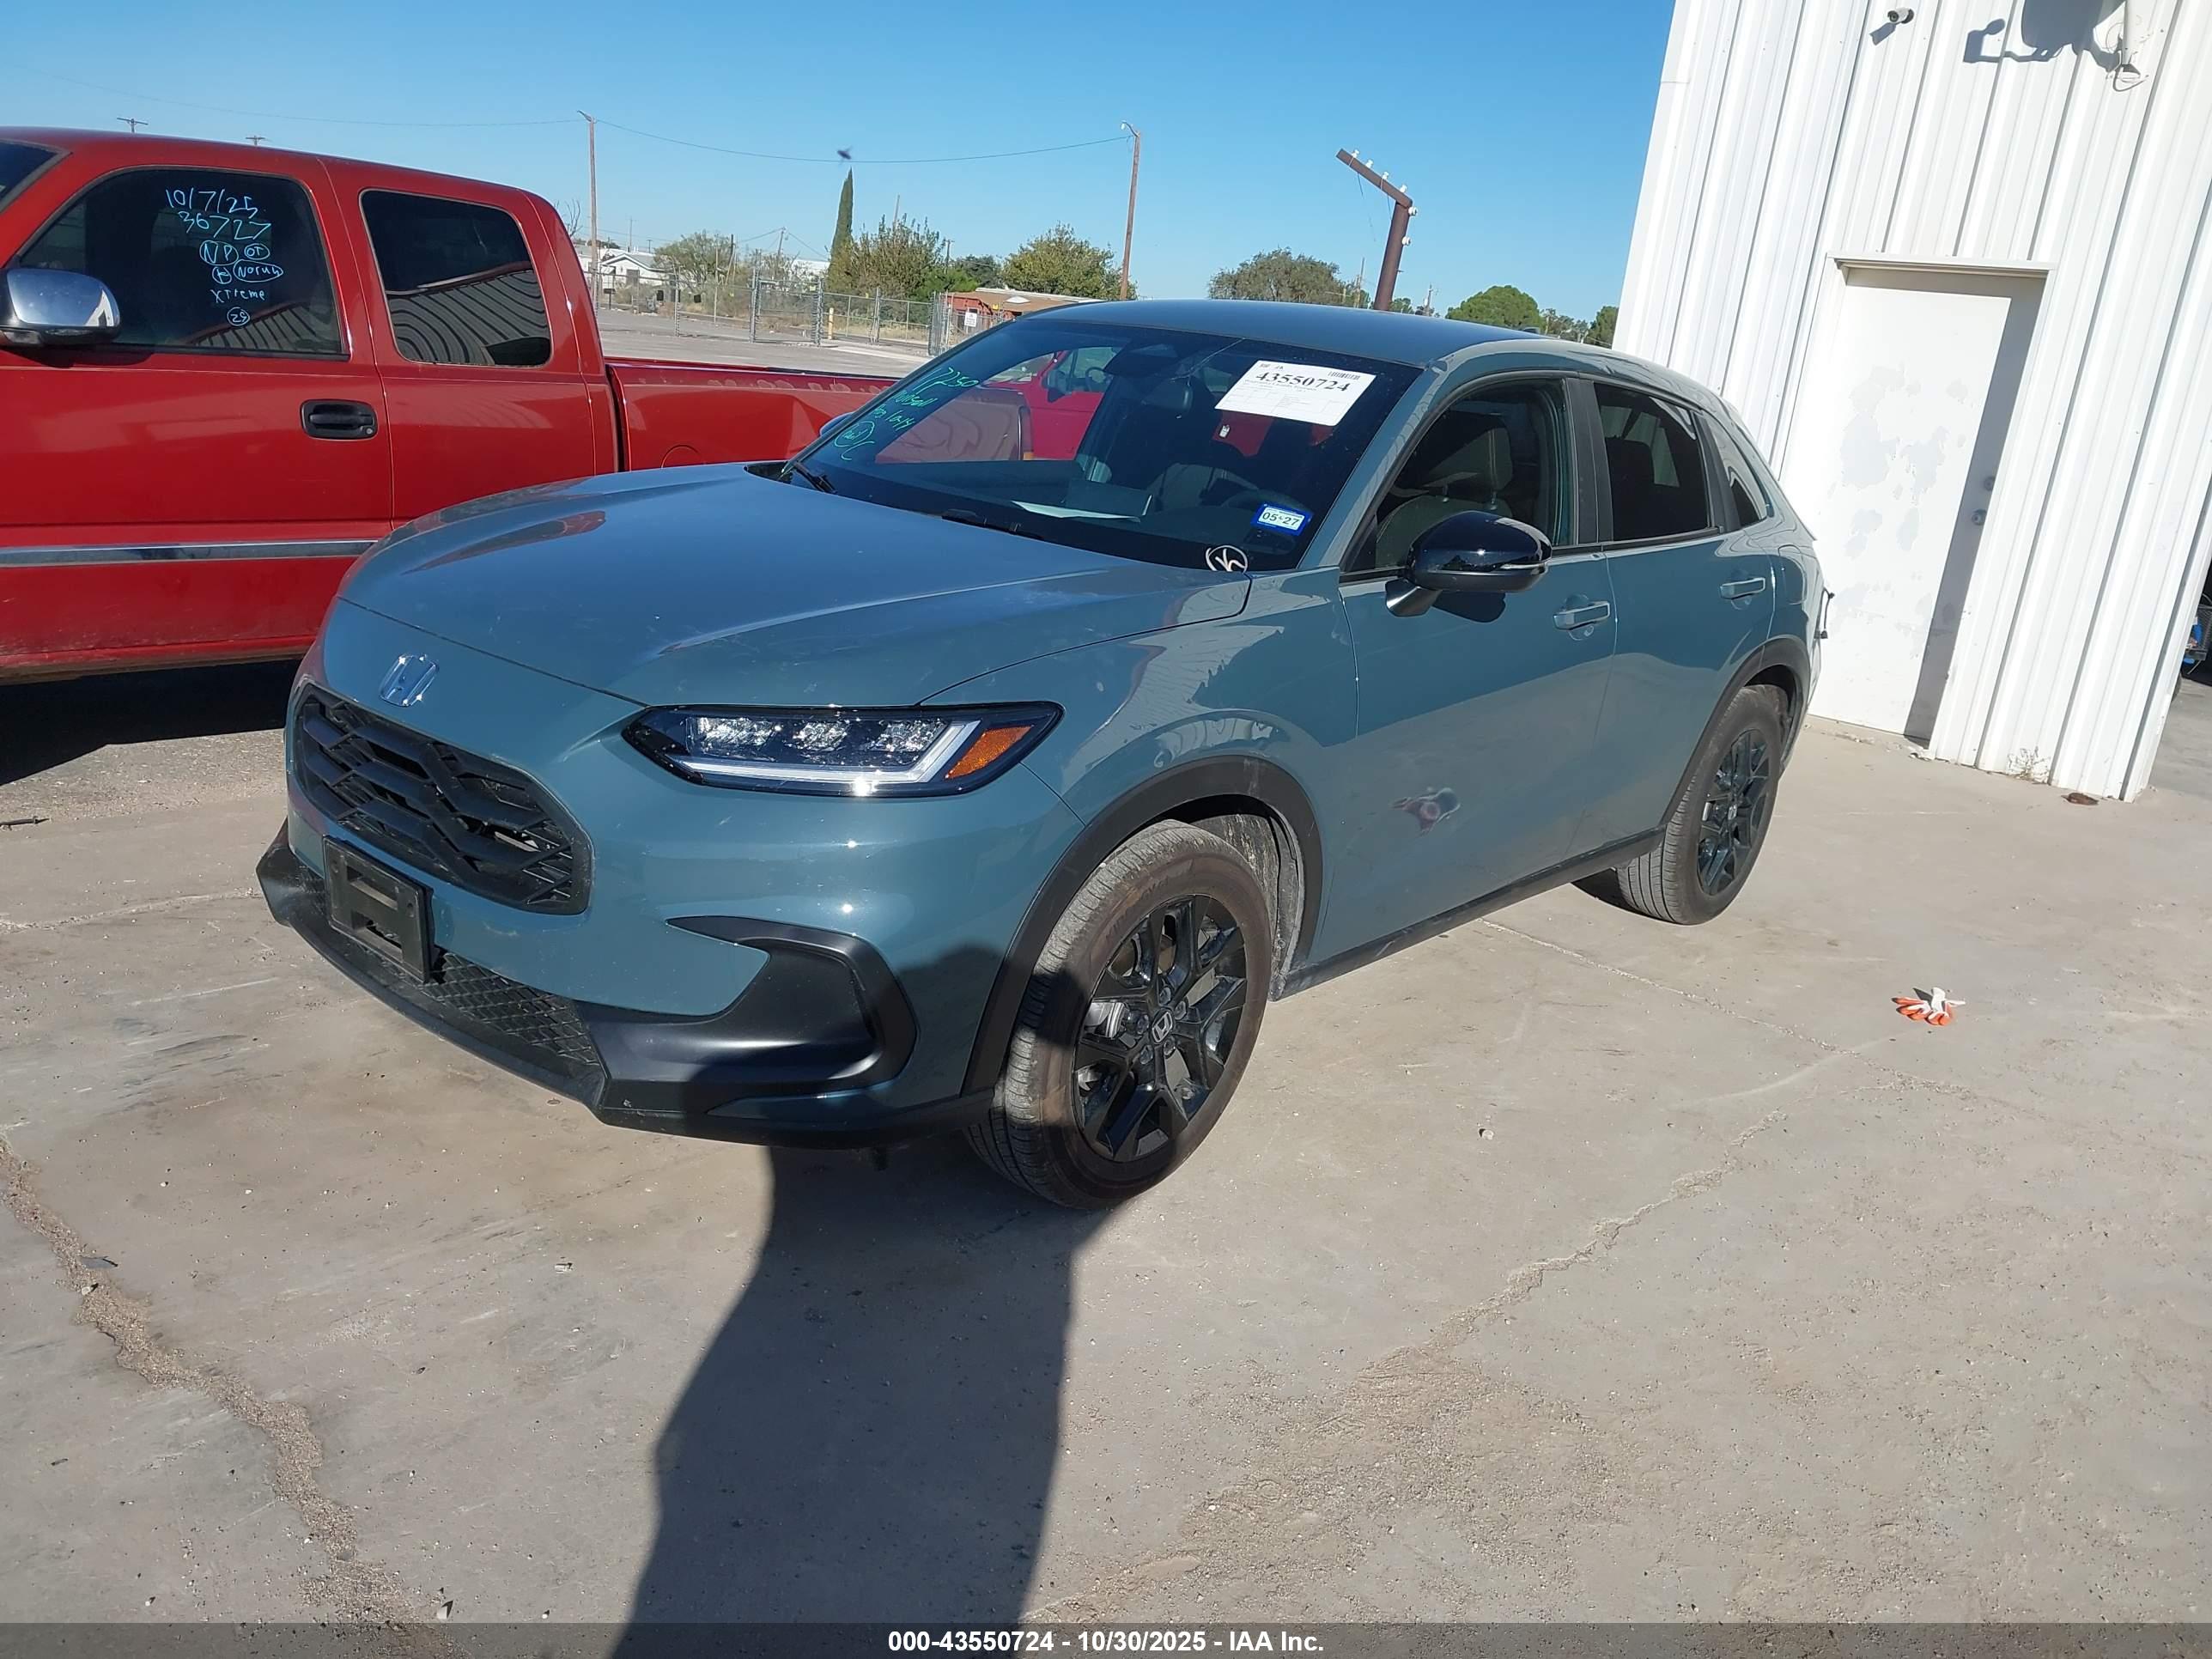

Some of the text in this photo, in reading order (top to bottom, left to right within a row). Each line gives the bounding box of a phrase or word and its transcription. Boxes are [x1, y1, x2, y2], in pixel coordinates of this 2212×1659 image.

[165, 187, 258, 219] 10/7/25
[178, 210, 272, 240] 36727
[1255, 372, 1351, 392] 43550724
